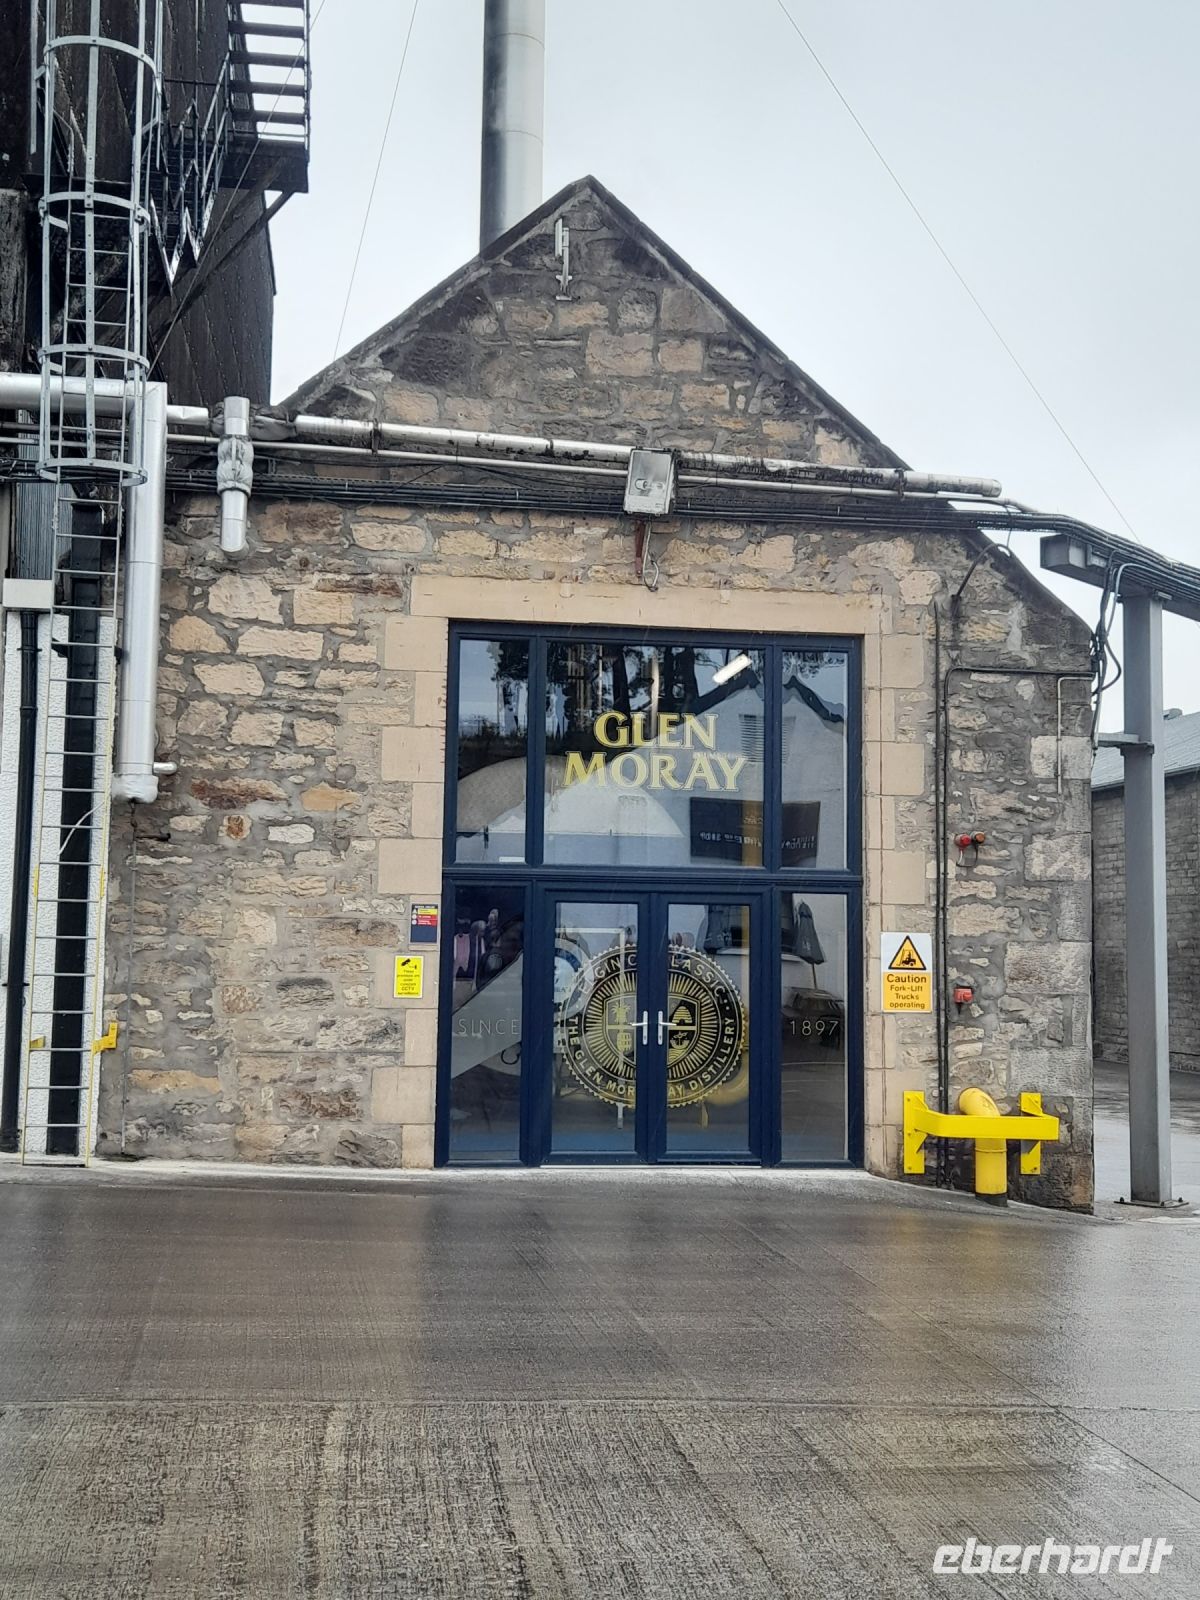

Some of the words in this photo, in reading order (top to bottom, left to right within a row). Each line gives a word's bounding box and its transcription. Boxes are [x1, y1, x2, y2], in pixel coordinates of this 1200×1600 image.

[594, 711, 718, 750] GLEN
[561, 751, 747, 792] MORAY
[886, 973, 927, 983] Caution
[895, 992, 920, 1000] Trucks
[889, 1001, 926, 1009] operating
[458, 1018, 521, 1035] SINCE
[790, 1020, 839, 1036] 1897
[568, 1017, 579, 1046] THE
[574, 1049, 604, 1085] GLEN
[689, 1017, 735, 1091] DISTILLERY
